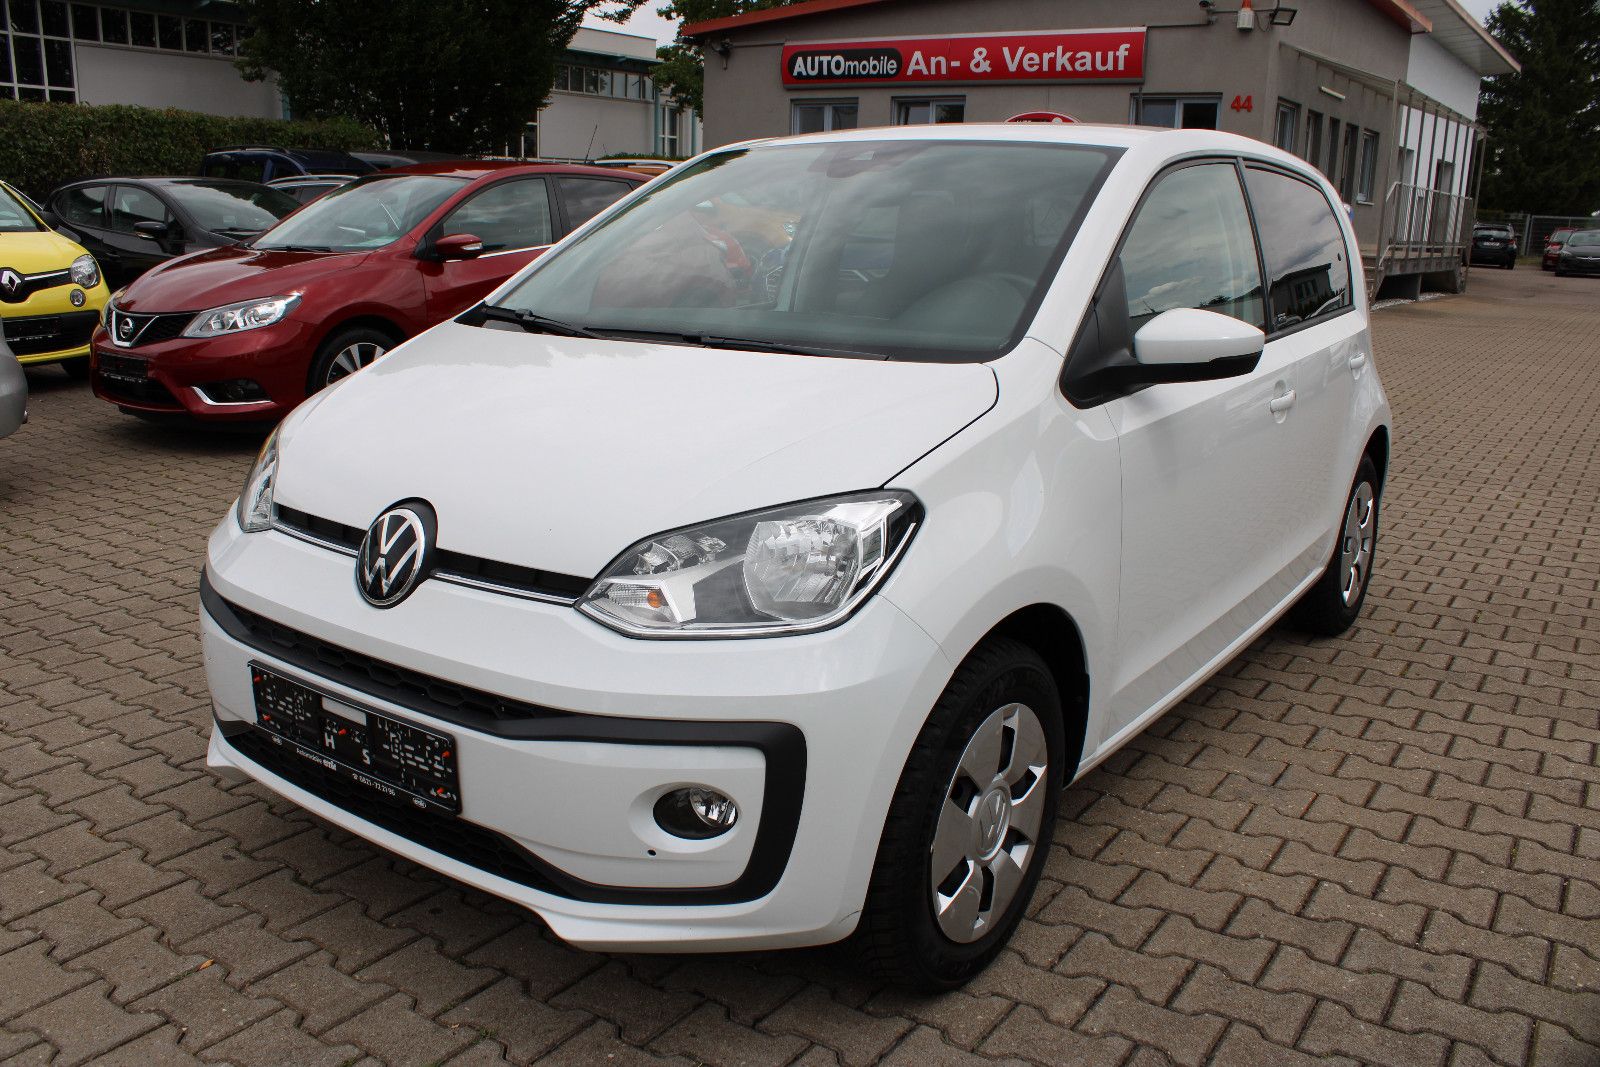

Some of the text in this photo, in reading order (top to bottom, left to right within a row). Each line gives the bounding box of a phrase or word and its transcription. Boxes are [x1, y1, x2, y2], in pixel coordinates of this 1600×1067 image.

[793, 43, 1131, 77] AUTOmobile An- & Verkauf
[1230, 95, 1253, 113] 44
